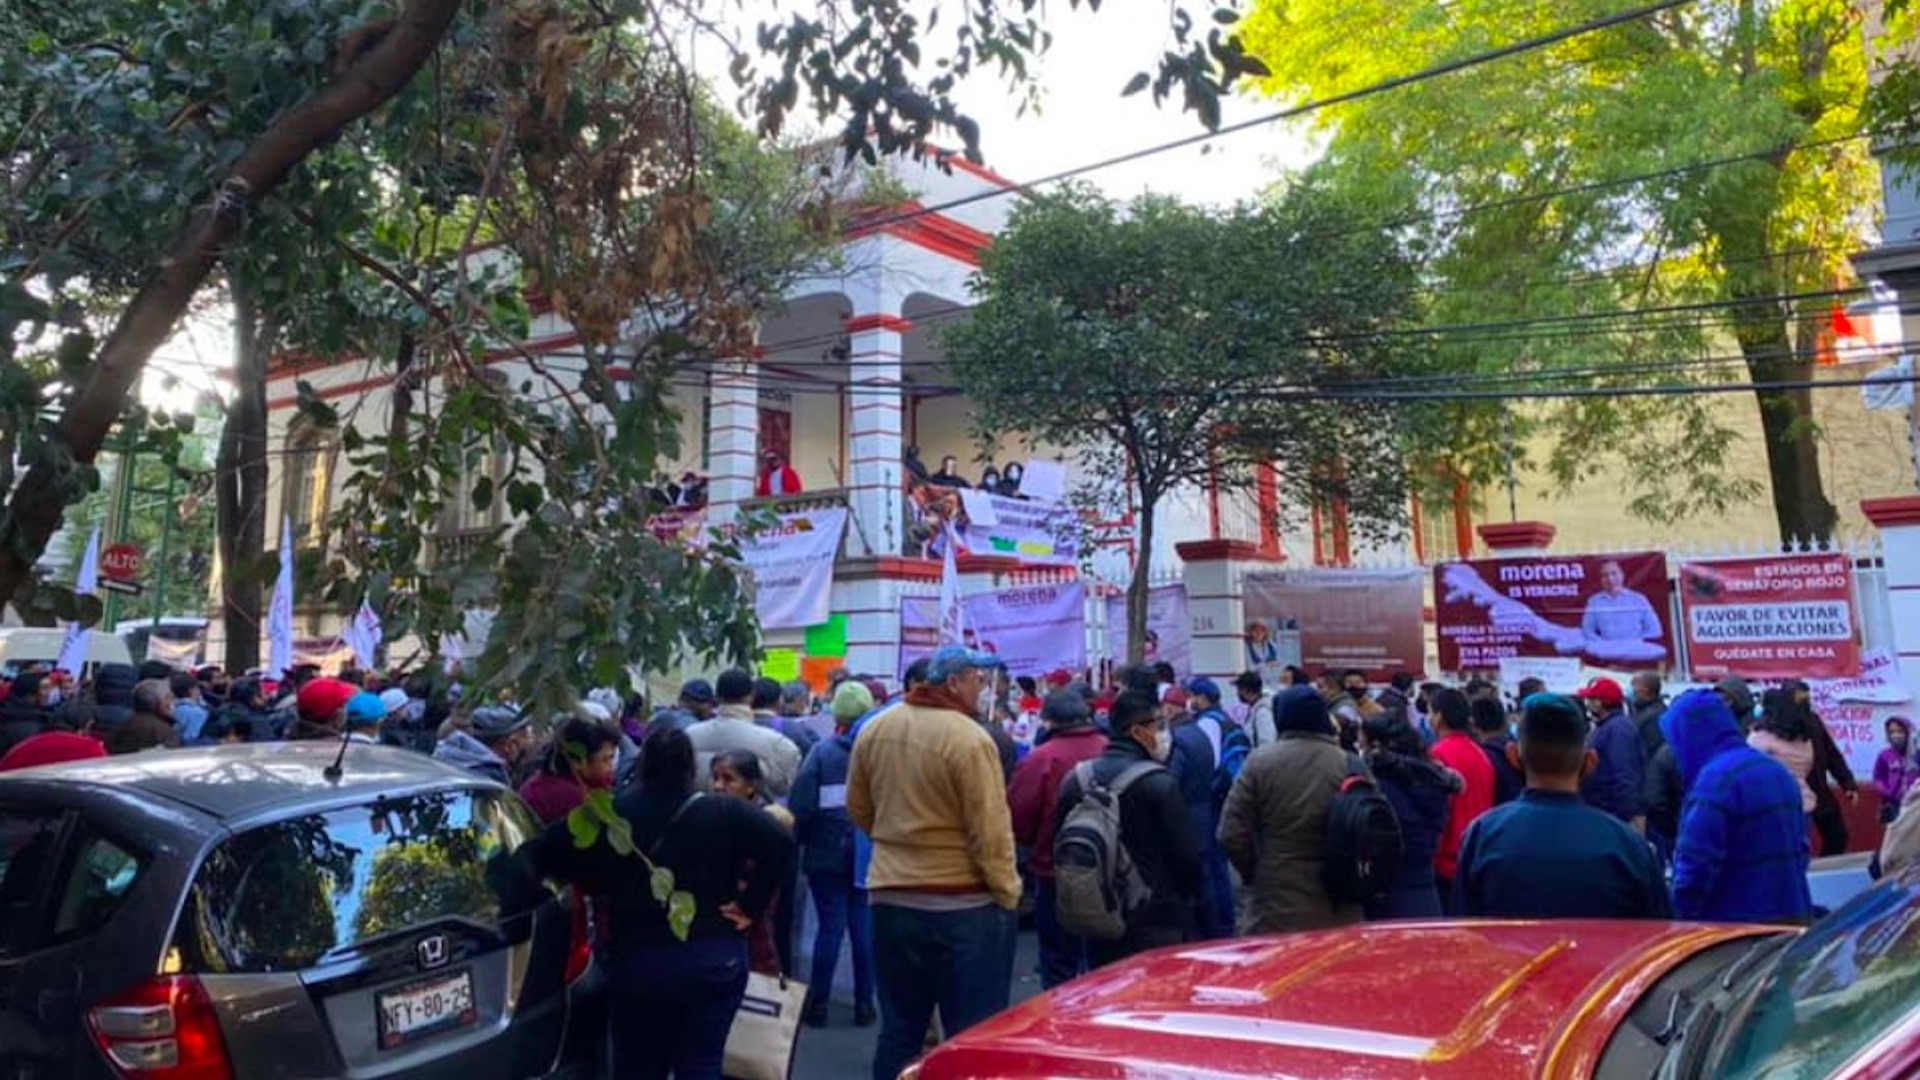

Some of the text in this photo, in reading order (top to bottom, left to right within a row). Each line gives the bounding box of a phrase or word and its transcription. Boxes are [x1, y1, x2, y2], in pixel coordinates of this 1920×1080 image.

[103, 552, 138, 570] ALTO
[1501, 563, 1585, 581] morena
[1754, 563, 1844, 577] ESTAMOS EN
[1806, 576, 1845, 589] ROJO
[1524, 584, 1579, 597] VERACRUZ
[1696, 605, 1840, 622] FAVOR DE EVITAR
[1696, 621, 1848, 637] AGLOMERACIONES
[1777, 647, 1796, 659] EN
[1797, 646, 1836, 659] CASA
